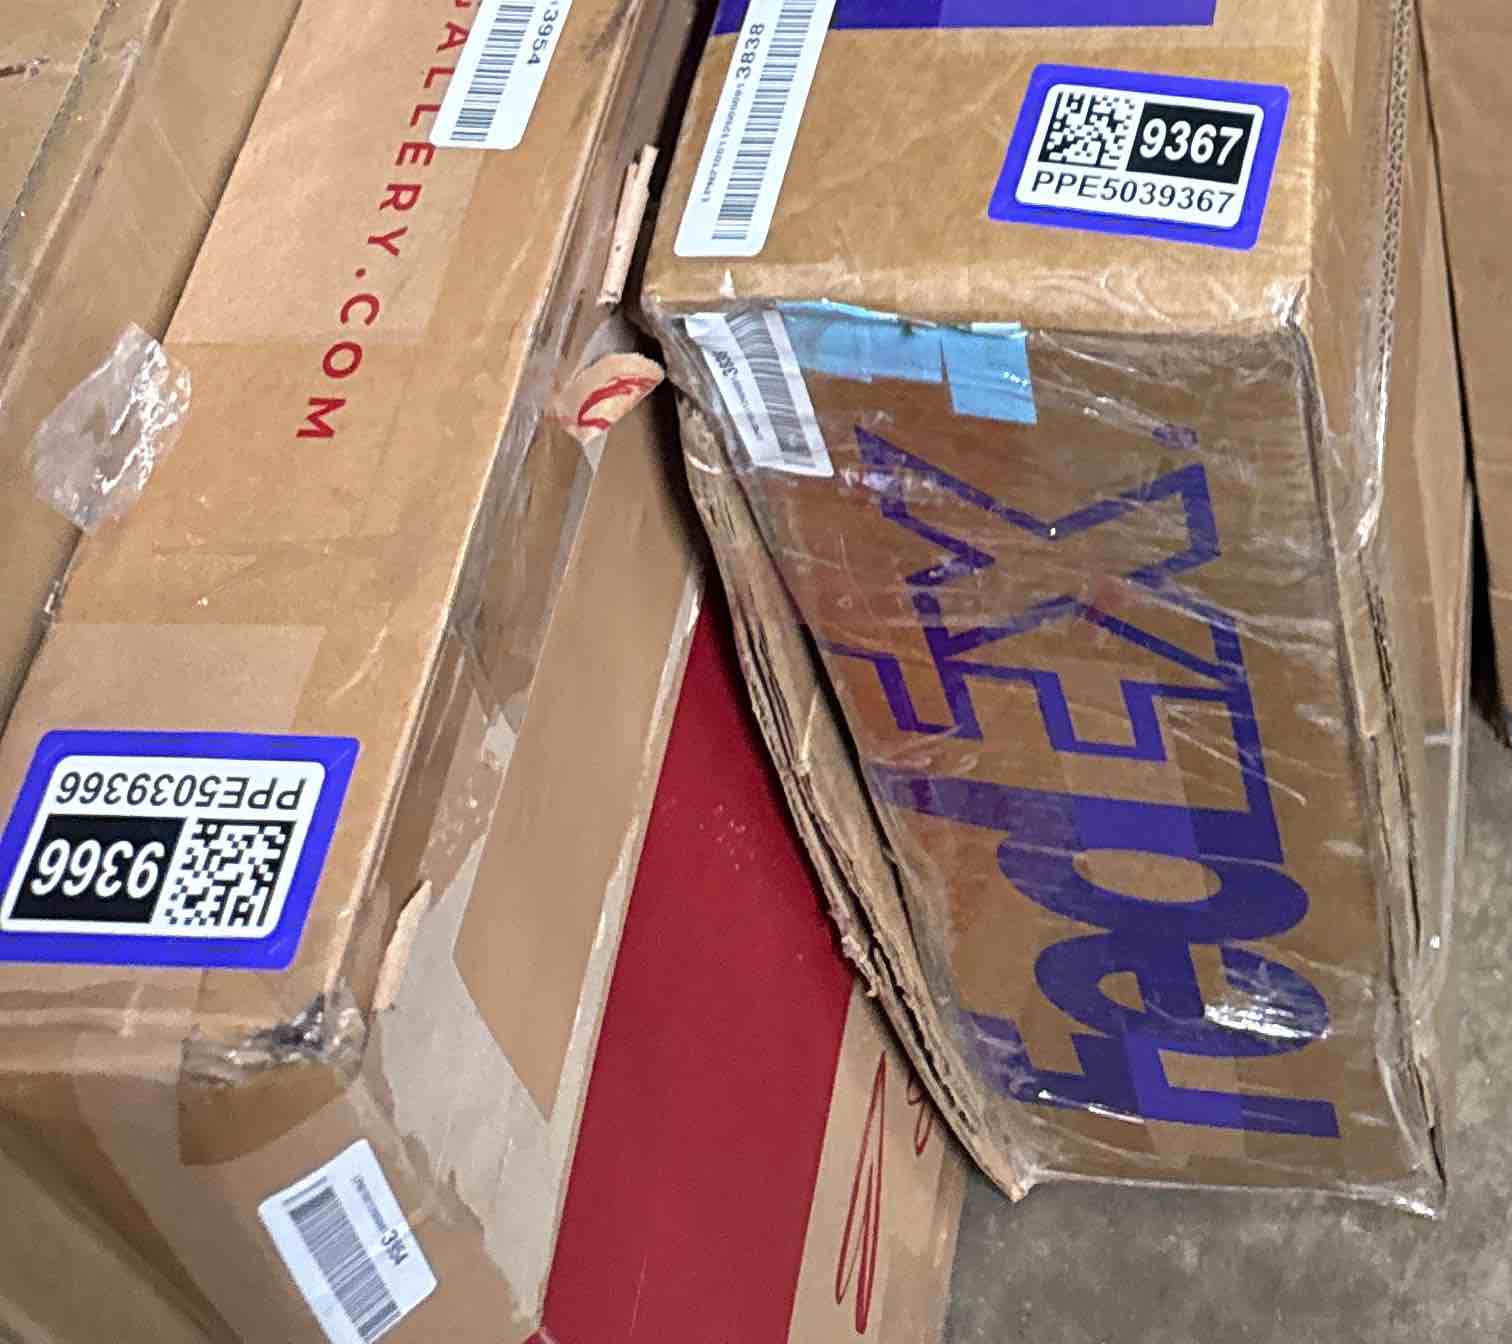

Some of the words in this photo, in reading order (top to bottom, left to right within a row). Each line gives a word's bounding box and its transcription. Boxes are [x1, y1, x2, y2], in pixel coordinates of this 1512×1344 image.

[525, 8, 560, 65] 3954
[734, 22, 766, 79] 3838
[1138, 109, 1243, 170] 9367
[1032, 172, 1236, 216] PPE5039367
[56, 771, 309, 811] PPE5039366
[31, 839, 166, 900] 9366
